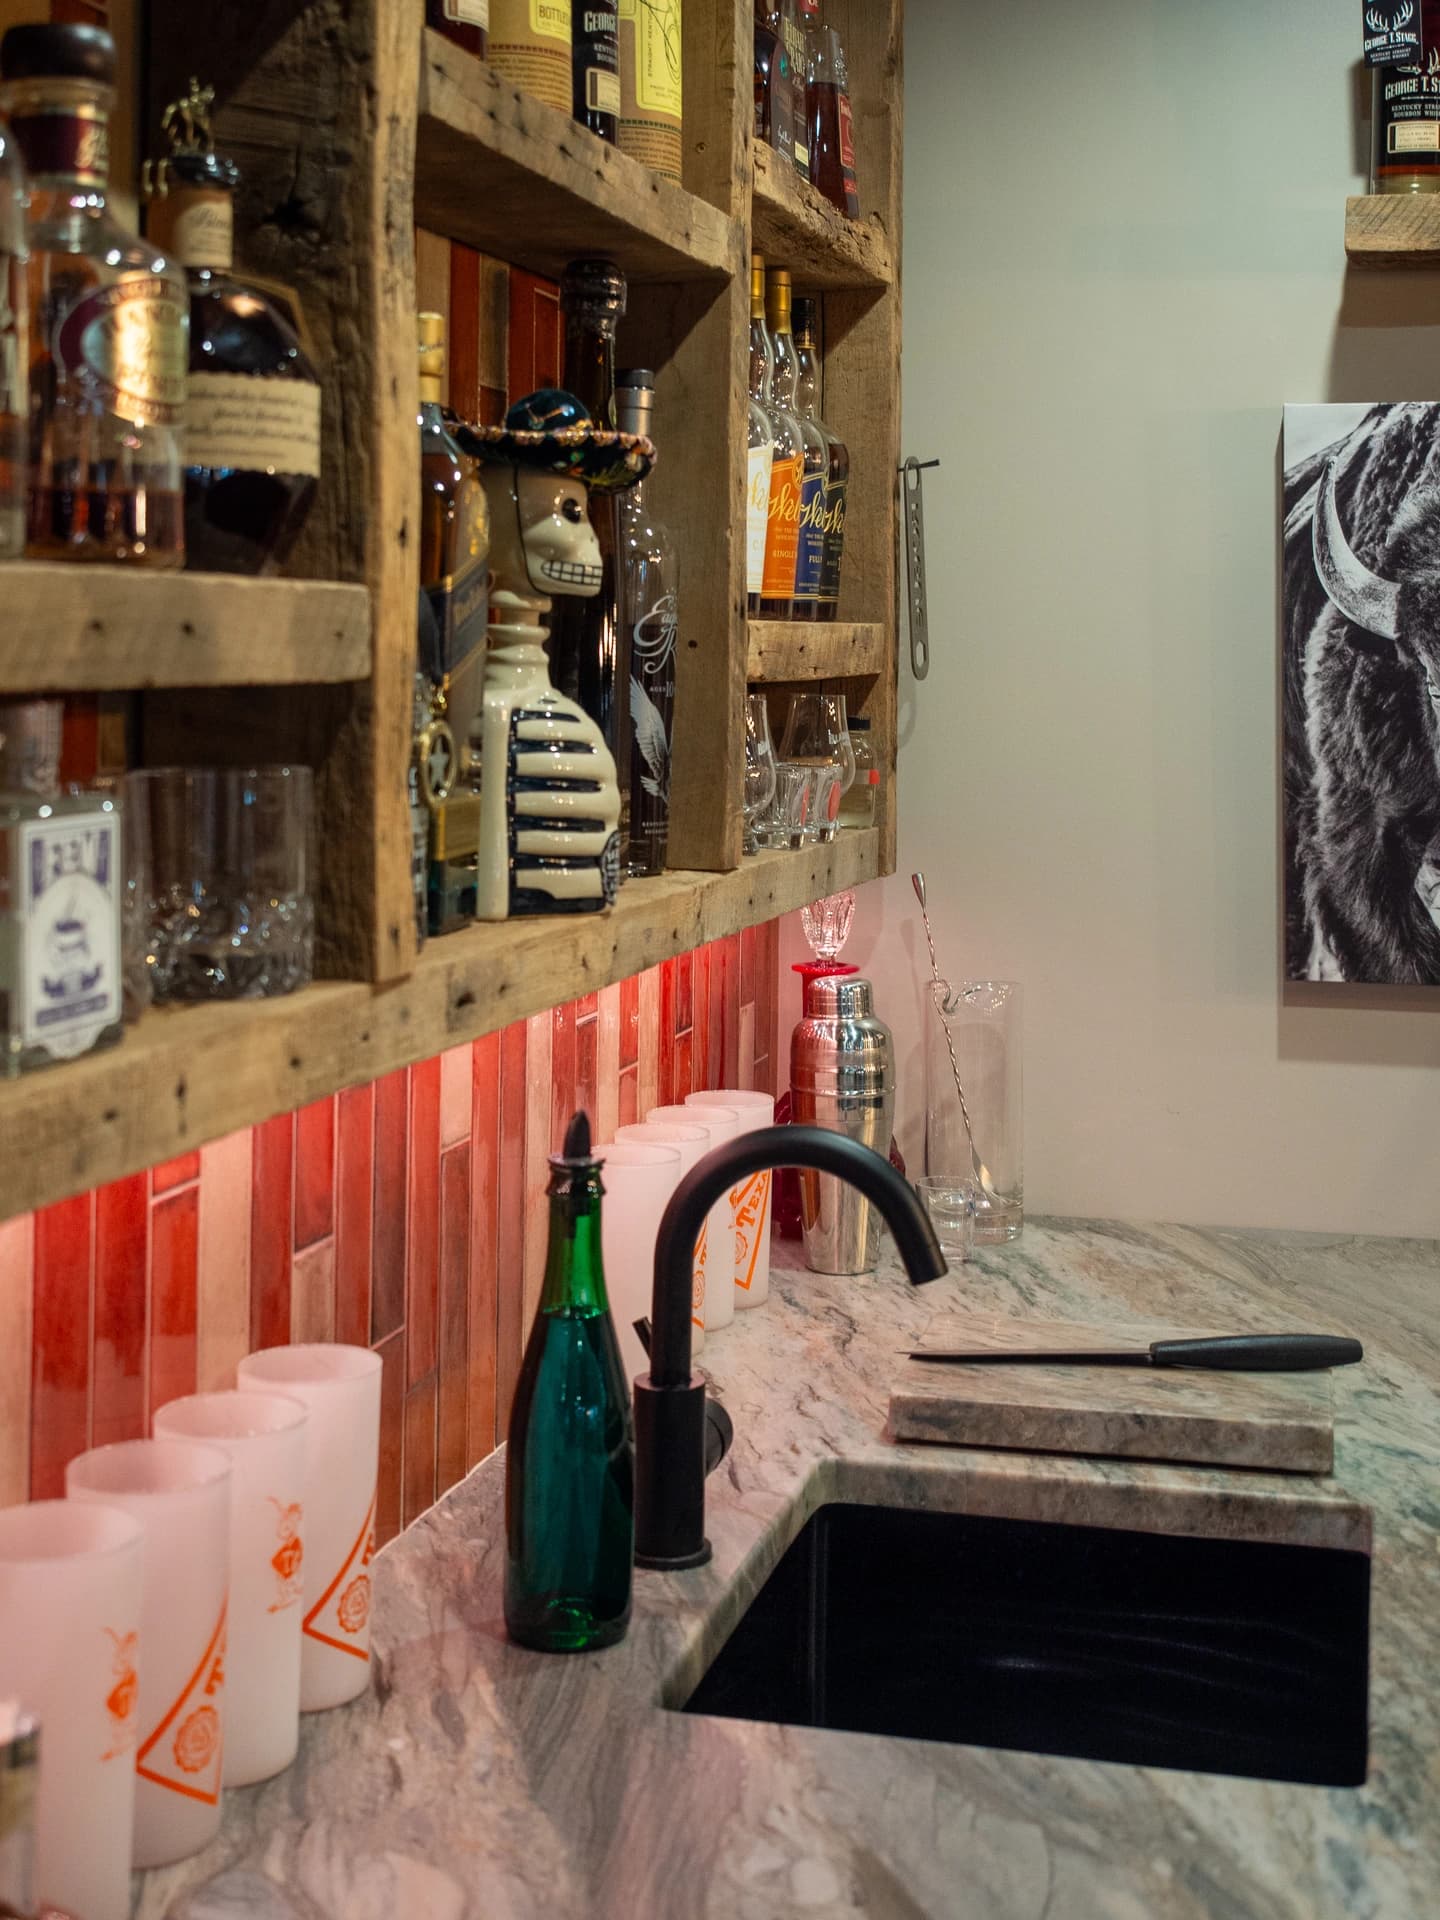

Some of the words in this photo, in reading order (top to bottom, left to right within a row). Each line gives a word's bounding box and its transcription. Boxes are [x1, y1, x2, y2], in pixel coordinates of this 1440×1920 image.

[1385, 79, 1418, 101] GEORGE
[1421, 76, 1430, 92] T.
[1391, 104, 1422, 112] KENTUCKY
[1393, 111, 1422, 119] BOURBON
